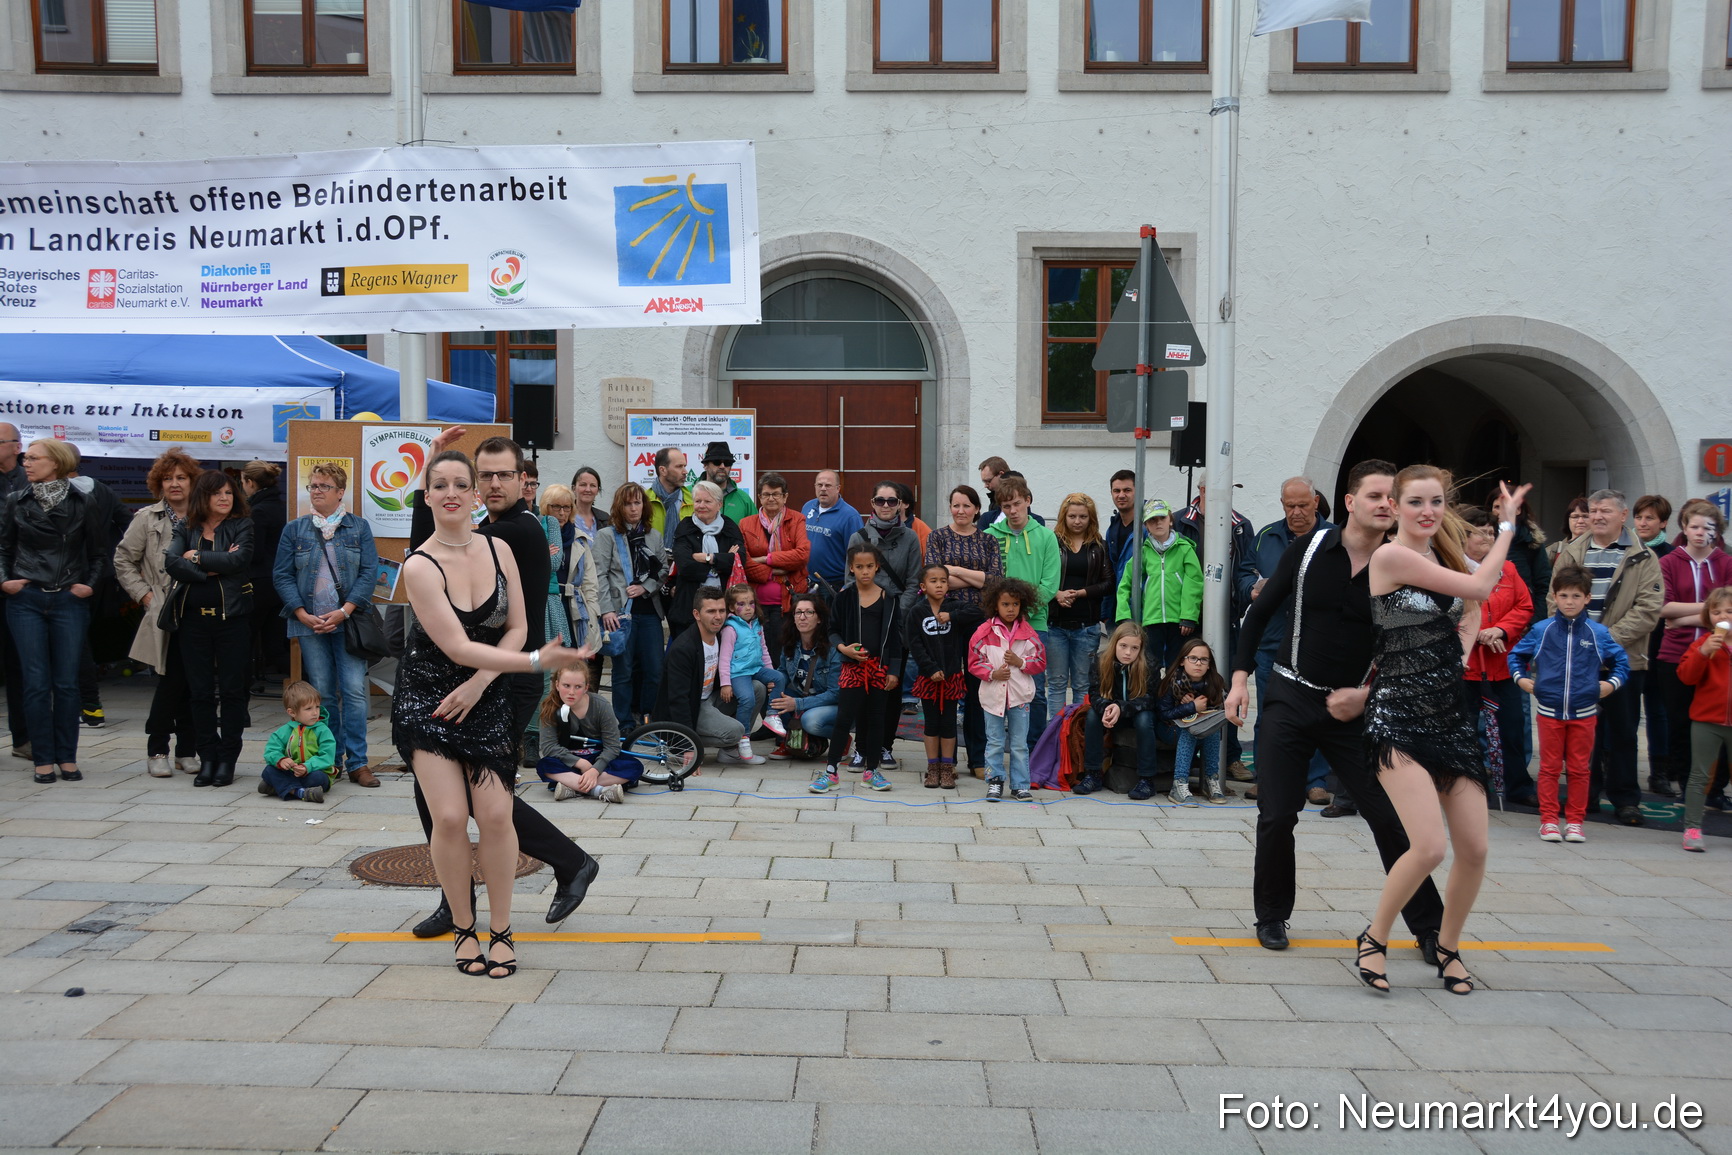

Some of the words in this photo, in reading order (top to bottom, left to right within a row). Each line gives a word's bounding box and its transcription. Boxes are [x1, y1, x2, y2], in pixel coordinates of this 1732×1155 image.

[189, 186, 282, 212] offene
[292, 175, 568, 208] Behindertenarbeit
[30, 227, 177, 251] Landkreis
[190, 219, 326, 250] Neumarkt
[336, 214, 449, 243] i.d.OPf.
[0, 267, 81, 282] Bayerisches
[118, 269, 159, 280] Caritas-
[201, 263, 258, 277] Diakonie
[201, 281, 274, 294] Nürnberger
[277, 278, 308, 291] Land
[350, 272, 398, 291] Regens
[401, 270, 459, 290] Wagner
[0, 281, 37, 294] Rotes
[117, 283, 183, 294] Sozialstation
[88, 300, 114, 310] caritas
[116, 298, 167, 309] Neumarkt
[170, 297, 190, 309] e.V.
[201, 296, 263, 309] Neumarkt
[85, 404, 122, 416] zur
[131, 402, 244, 420] Inklusion
[162, 432, 183, 441] Regens
[185, 433, 208, 441] Wagner
